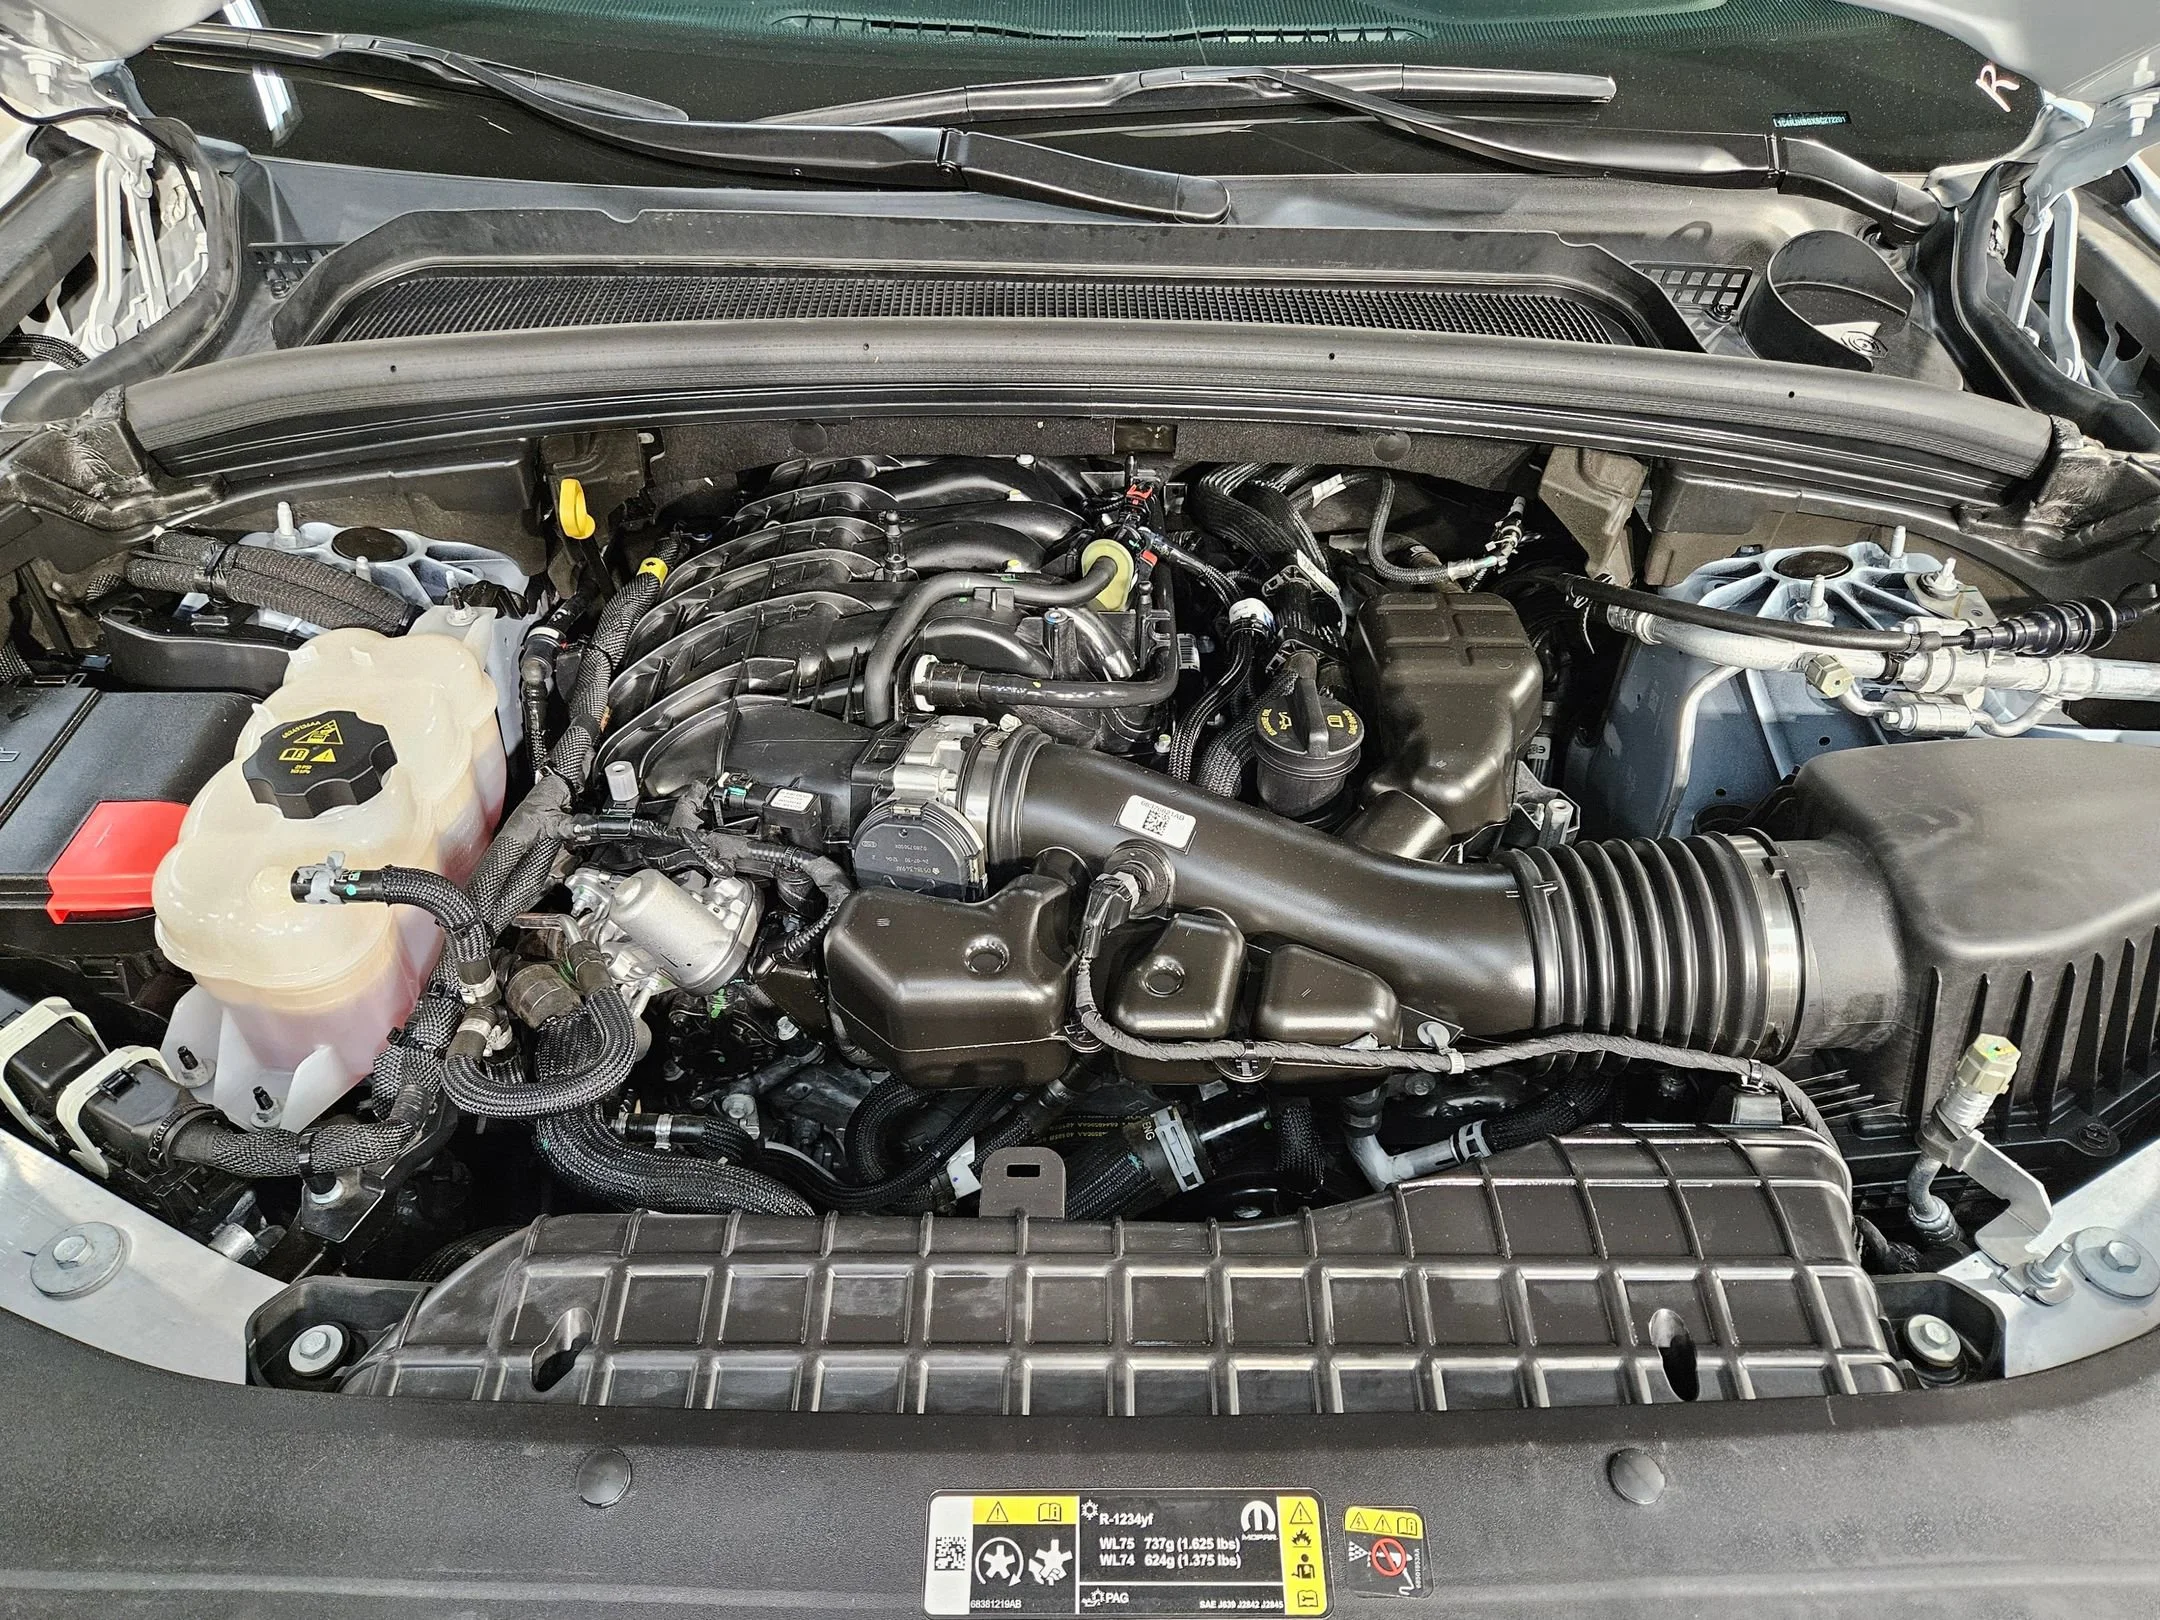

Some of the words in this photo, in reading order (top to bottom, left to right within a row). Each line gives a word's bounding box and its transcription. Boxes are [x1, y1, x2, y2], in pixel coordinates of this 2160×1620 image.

[1976, 64, 2020, 113] R
[1142, 1121, 1156, 1141] ENG
[1099, 1513, 1154, 1528] R-1234yf
[1099, 1537, 1135, 1550] WL75
[1144, 1537, 1175, 1552] 737g
[1177, 1537, 1214, 1552] (1.625
[1217, 1537, 1240, 1552] lbs)
[1099, 1554, 1135, 1566] WL74
[1144, 1554, 1175, 1569] 624g
[1178, 1554, 1215, 1569] (1.375
[1217, 1554, 1241, 1569] lbs)
[970, 1600, 1022, 1609] 68381219AB
[1105, 1592, 1129, 1604] PAG
[1199, 1600, 1216, 1609] SAE
